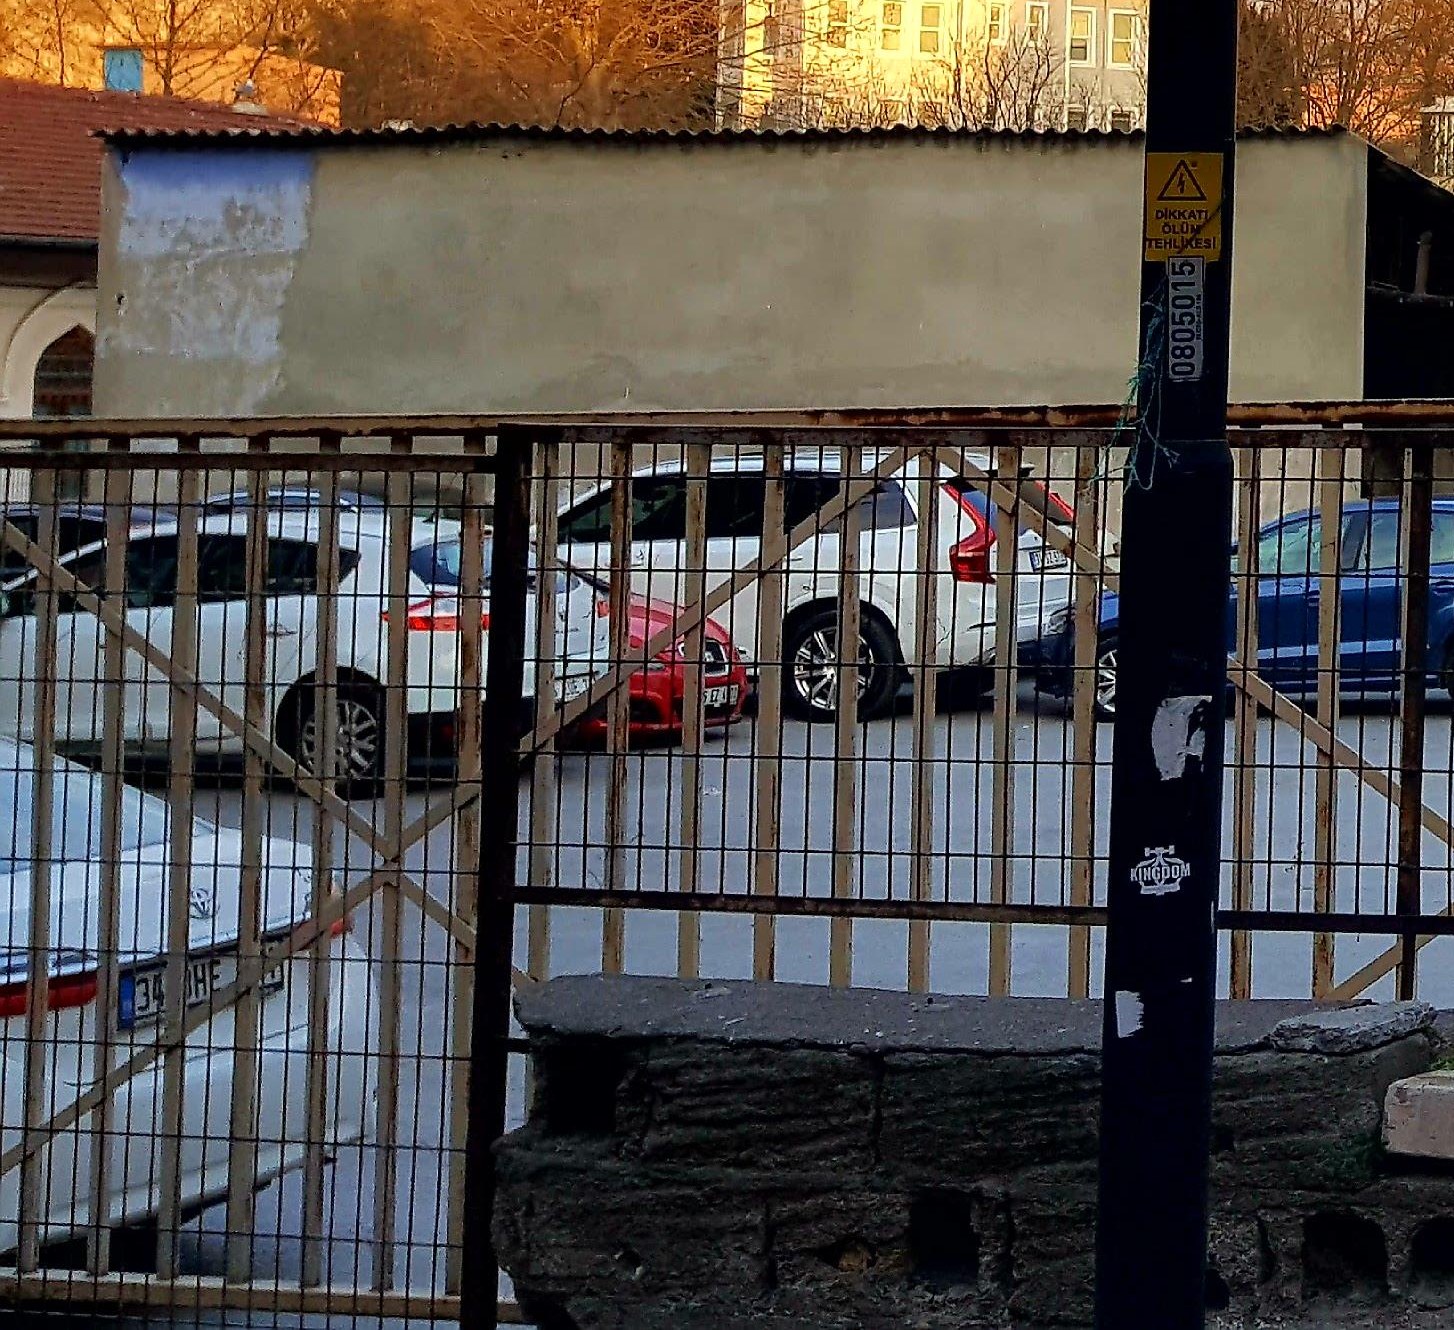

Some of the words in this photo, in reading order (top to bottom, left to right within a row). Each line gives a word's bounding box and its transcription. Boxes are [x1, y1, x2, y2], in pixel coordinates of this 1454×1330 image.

[1146, 236, 1216, 249] TEHLİKESİ
[1171, 262, 1195, 376] 0805015
[1130, 862, 1191, 882] KINGDOM
